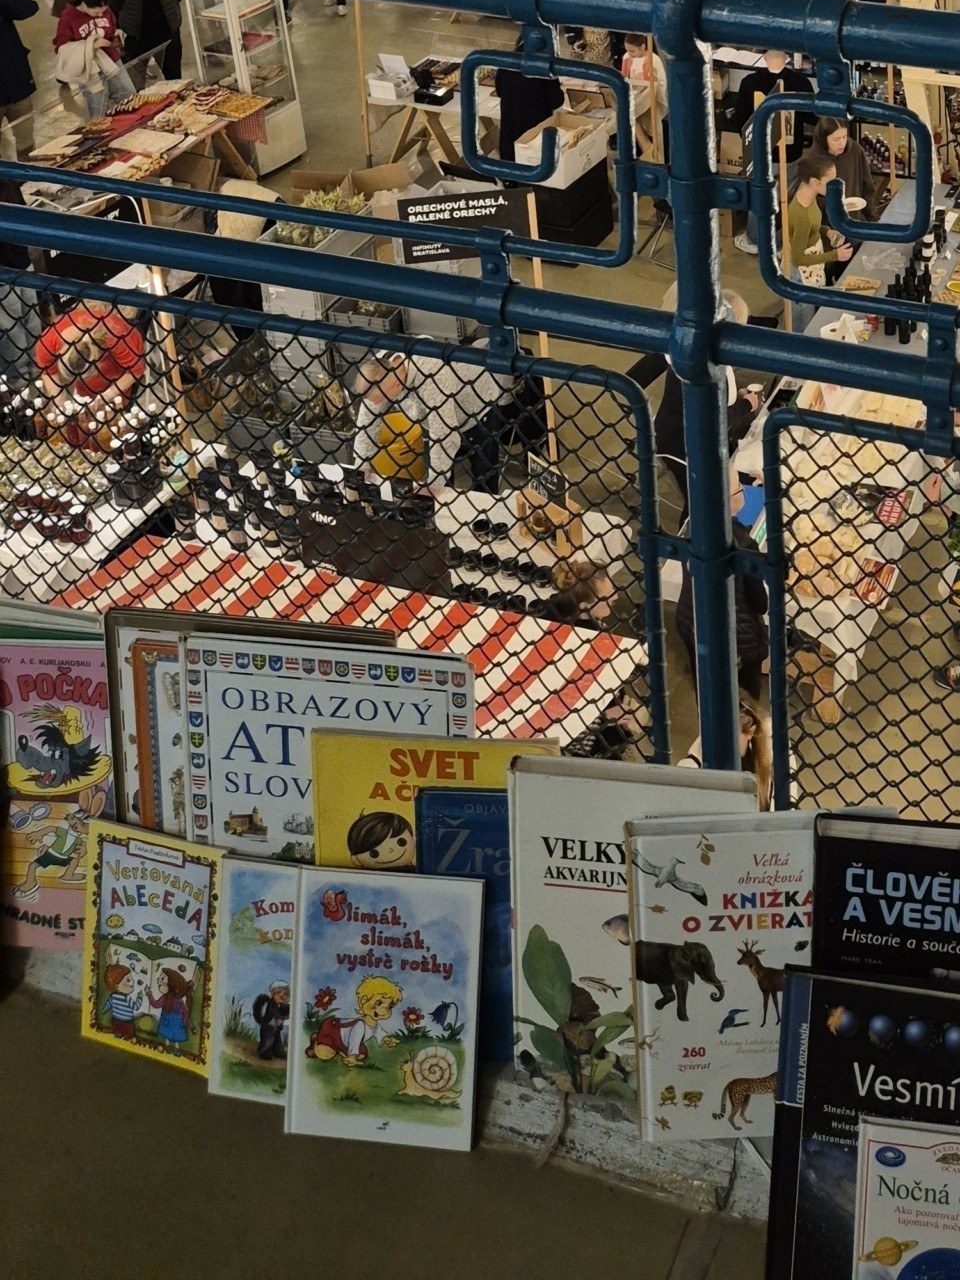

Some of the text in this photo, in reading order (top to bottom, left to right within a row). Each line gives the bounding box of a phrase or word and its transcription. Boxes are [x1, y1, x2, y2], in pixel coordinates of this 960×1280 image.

[407, 195, 508, 214] ORECHOVÉ MASLÁ,
[408, 207, 497, 222] BALENÉ ORECHY
[412, 248, 450, 257] BRATISLAVA
[17, 666, 108, 710] POČKA
[221, 687, 434, 726] OBRAZOVÝ
[221, 721, 305, 766] AT
[390, 747, 480, 781] SVET
[225, 771, 313, 800] SLOV
[369, 781, 391, 801] A
[753, 852, 791, 868] Veľká
[105, 859, 209, 904] Veršovaná
[738, 869, 805, 887] obrázková
[722, 888, 813, 910] KNIŽKA
[842, 896, 867, 923] A
[682, 910, 813, 933] O ZVIERAT
[360, 926, 431, 953] slimák,
[842, 927, 901, 947] Historie
[907, 938, 917, 949] a
[336, 948, 454, 981] vystrč rožky
[682, 1046, 707, 1058] 260
[677, 1061, 711, 1072] zvierat
[877, 1174, 950, 1206] Nočná
[894, 1205, 913, 1216] Ako
[915, 1209, 960, 1222] pozorovať
